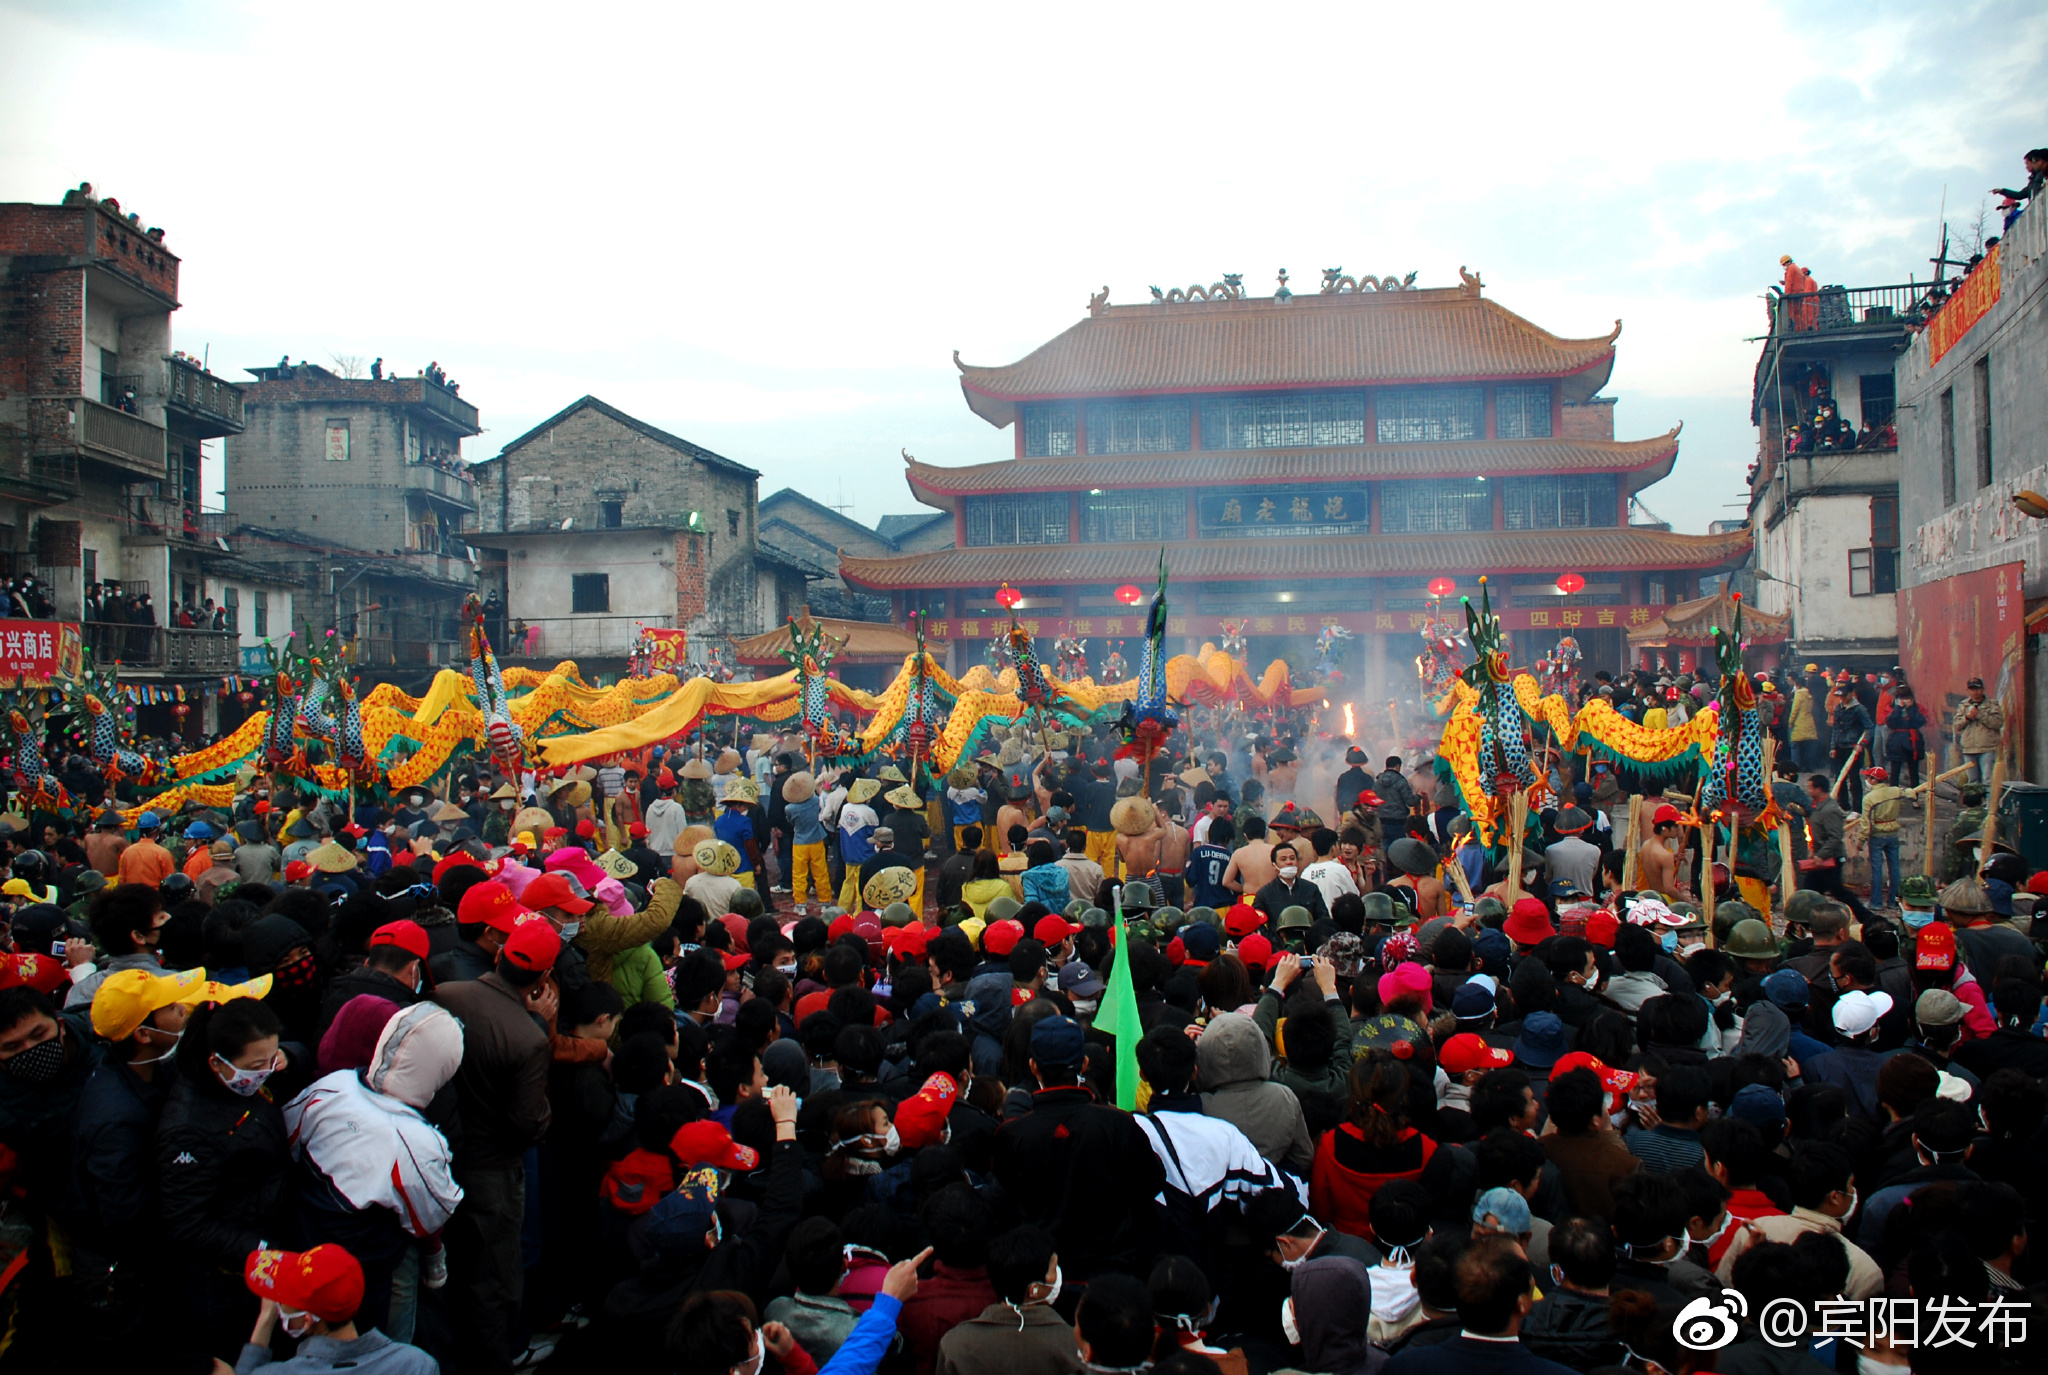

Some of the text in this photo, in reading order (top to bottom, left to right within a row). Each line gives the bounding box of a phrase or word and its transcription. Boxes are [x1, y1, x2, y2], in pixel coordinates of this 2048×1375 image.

[1530, 608, 1651, 626] 四时吉祥
[0, 630, 53, 660] 兴商店
[1208, 860, 1221, 885] 9
[1310, 868, 1326, 880] BAPE
